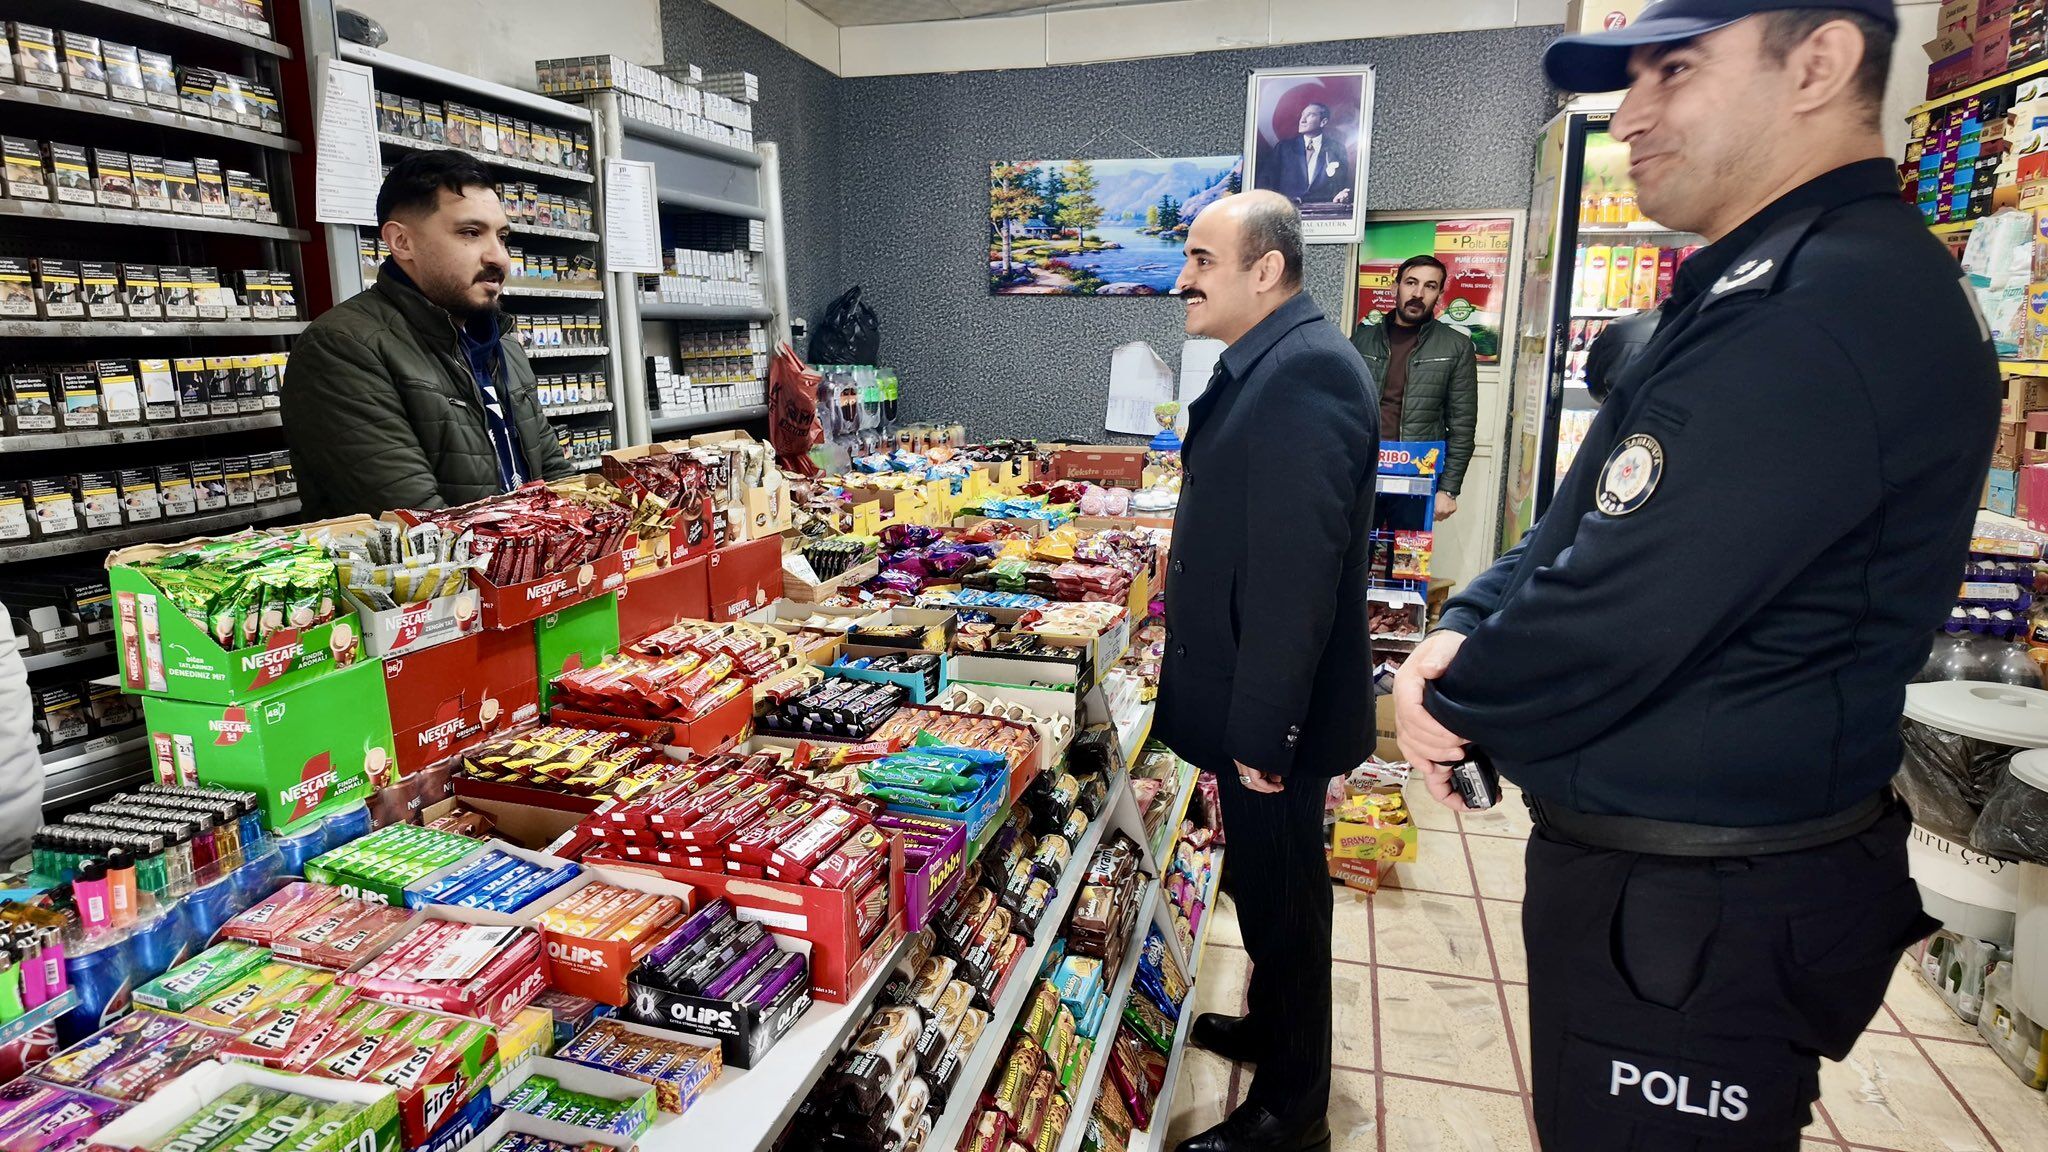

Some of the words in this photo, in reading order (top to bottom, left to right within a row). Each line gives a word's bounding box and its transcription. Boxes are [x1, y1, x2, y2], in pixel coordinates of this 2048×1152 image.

[1489, 235, 1508, 249] Tea
[1455, 256, 1471, 264] PURE
[1472, 256, 1494, 264] CEYLON
[1379, 450, 1411, 463] RIBO
[525, 579, 568, 601] NESCAFE
[385, 607, 434, 632] NESCAFE
[241, 642, 305, 673] NESCAFE
[297, 654, 328, 670] AROMALI
[301, 650, 324, 663] FINDIK
[209, 719, 253, 734] NESCAFE
[268, 708, 280, 718] 48
[417, 717, 467, 748] NESCAFE
[456, 723, 481, 738] ORIGINAL
[280, 770, 340, 806] NESCAFE
[333, 779, 364, 797] AROMALI
[336, 774, 359, 788] FINDIK
[1912, 826, 1951, 854] uru
[928, 848, 962, 897] hobby
[298, 916, 342, 943] First
[334, 930, 370, 951] First
[163, 961, 215, 993] First
[211, 982, 263, 1015] First
[252, 1008, 300, 1049] First
[671, 1002, 737, 1030] OLiPS.
[328, 1034, 383, 1077] First
[571, 1031, 604, 1056] FALIM
[383, 1045, 434, 1089] First
[423, 1071, 463, 1127] First
[1609, 1060, 1749, 1122] POLiS
